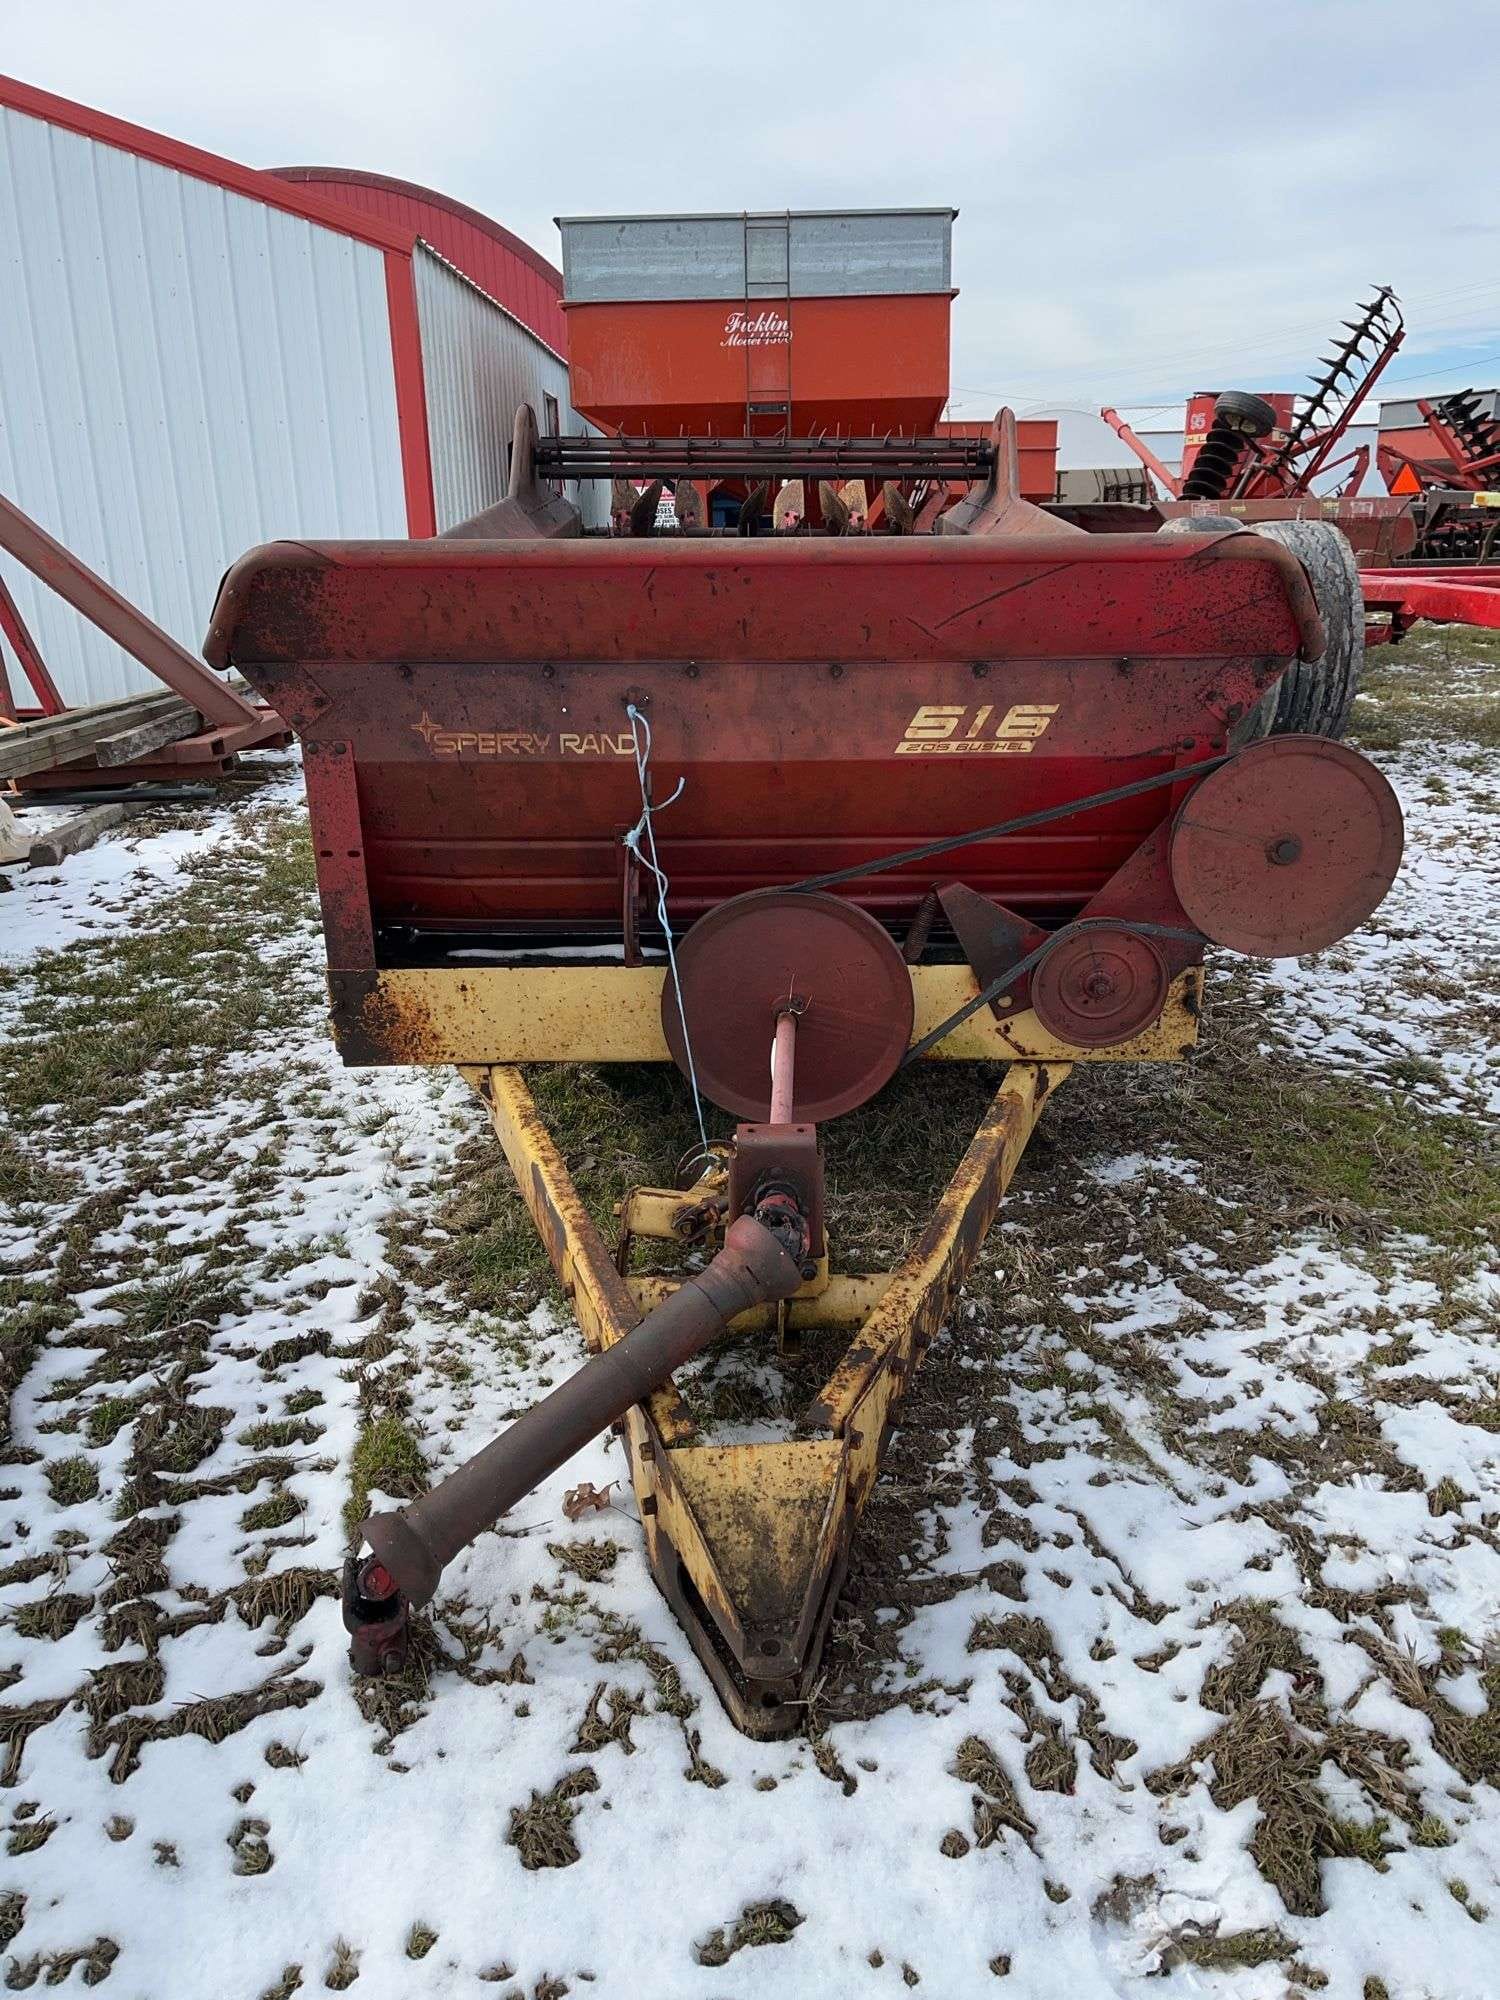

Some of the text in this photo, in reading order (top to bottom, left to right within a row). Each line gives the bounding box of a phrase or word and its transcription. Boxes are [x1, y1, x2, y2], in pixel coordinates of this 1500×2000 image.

[724, 312, 788, 333] Ficklin
[904, 704, 1060, 739] 516
[433, 733, 636, 755] SPERRY RAND
[906, 742, 1028, 752] 205 BUSHEL
